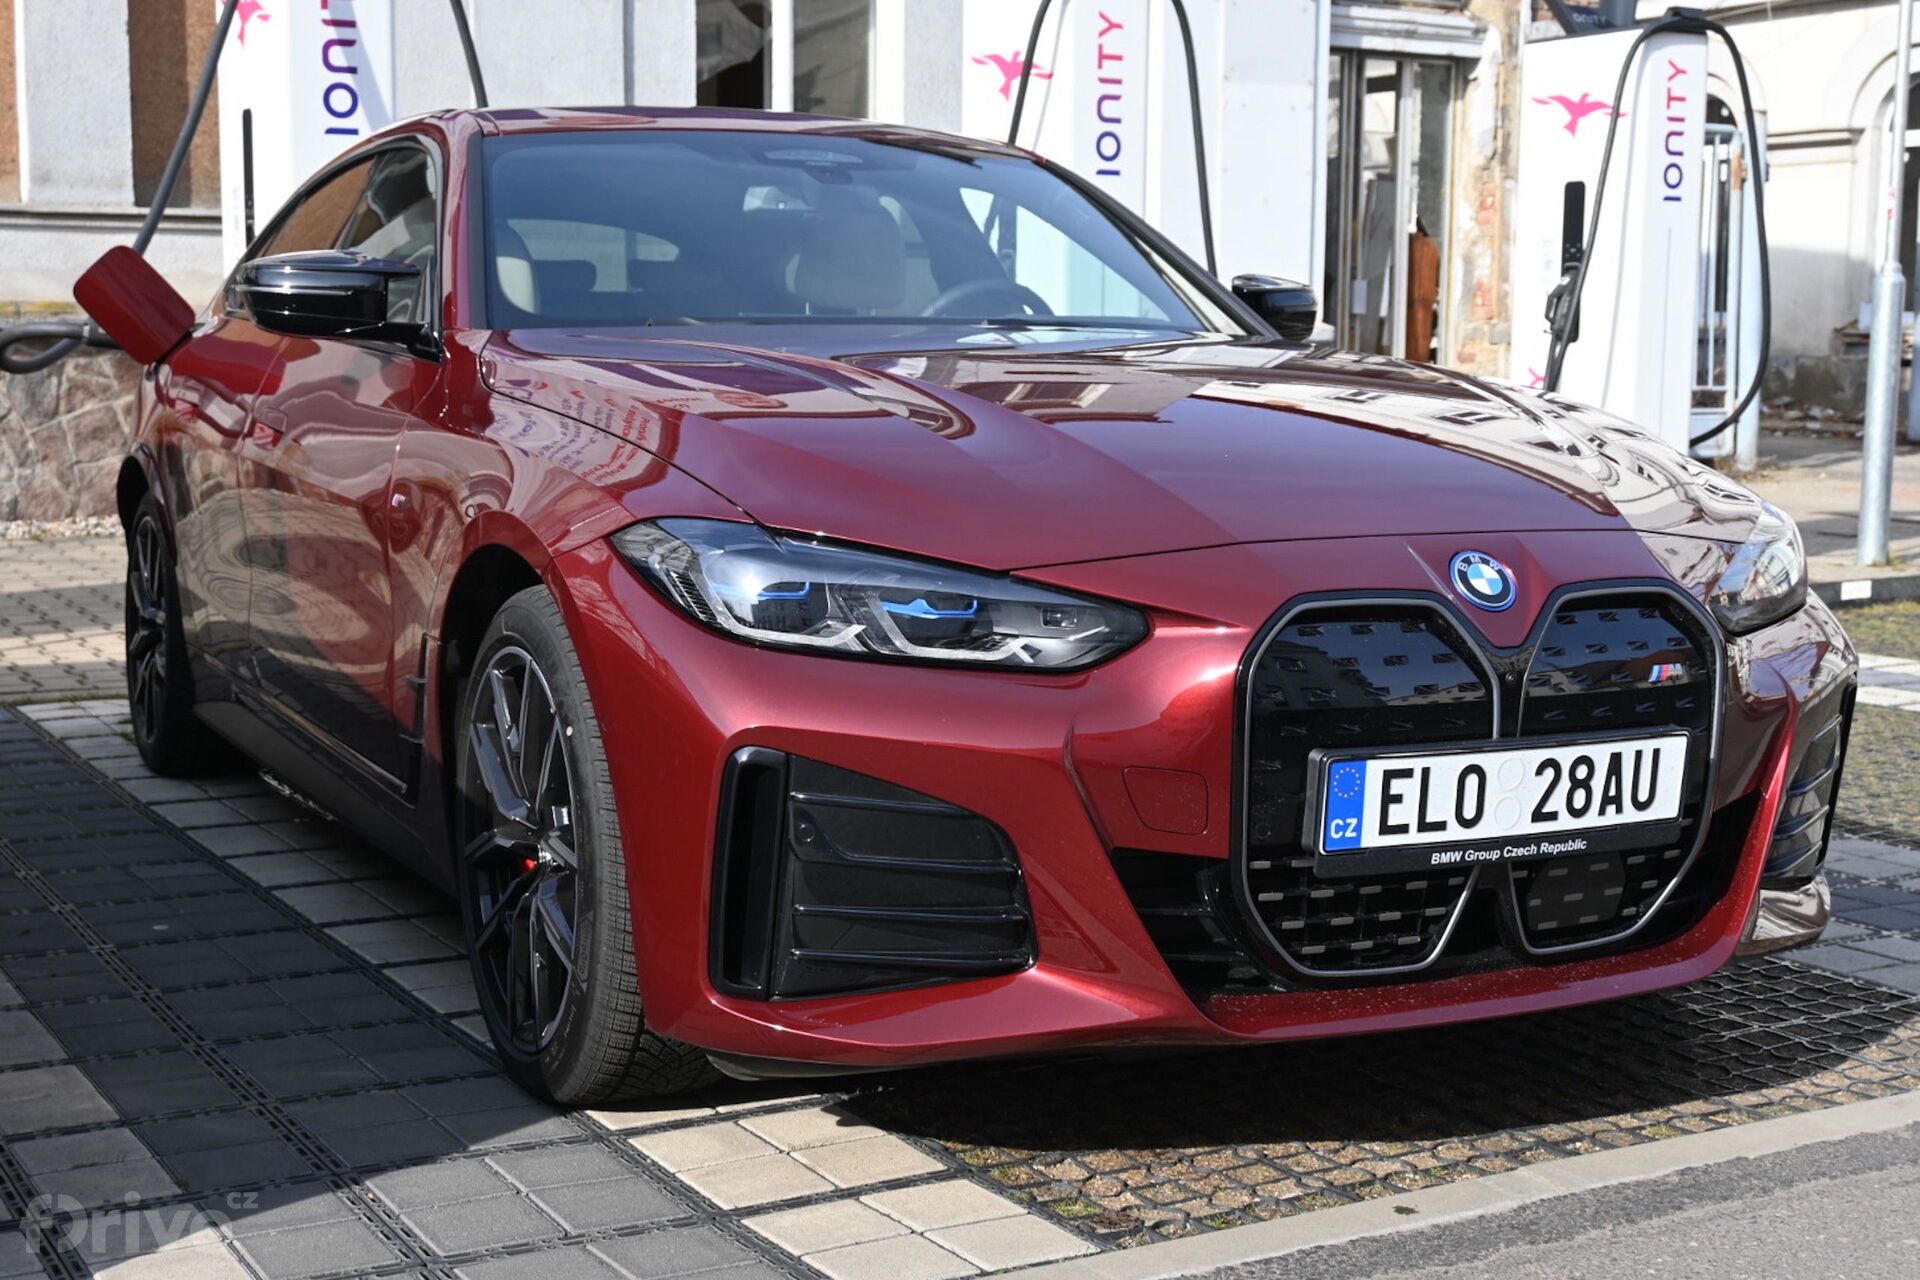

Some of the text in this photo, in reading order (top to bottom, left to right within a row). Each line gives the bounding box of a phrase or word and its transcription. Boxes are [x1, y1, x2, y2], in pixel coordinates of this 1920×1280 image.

[320, 0, 359, 136] IONI
[1096, 11, 1124, 176] IONITY
[1663, 59, 1688, 202] IONITY
[1458, 555, 1501, 572] BMW
[1531, 748, 1661, 823] 28AU
[1330, 818, 1357, 839] CZ
[1431, 839, 1587, 865] BMW Group Czech Republic
